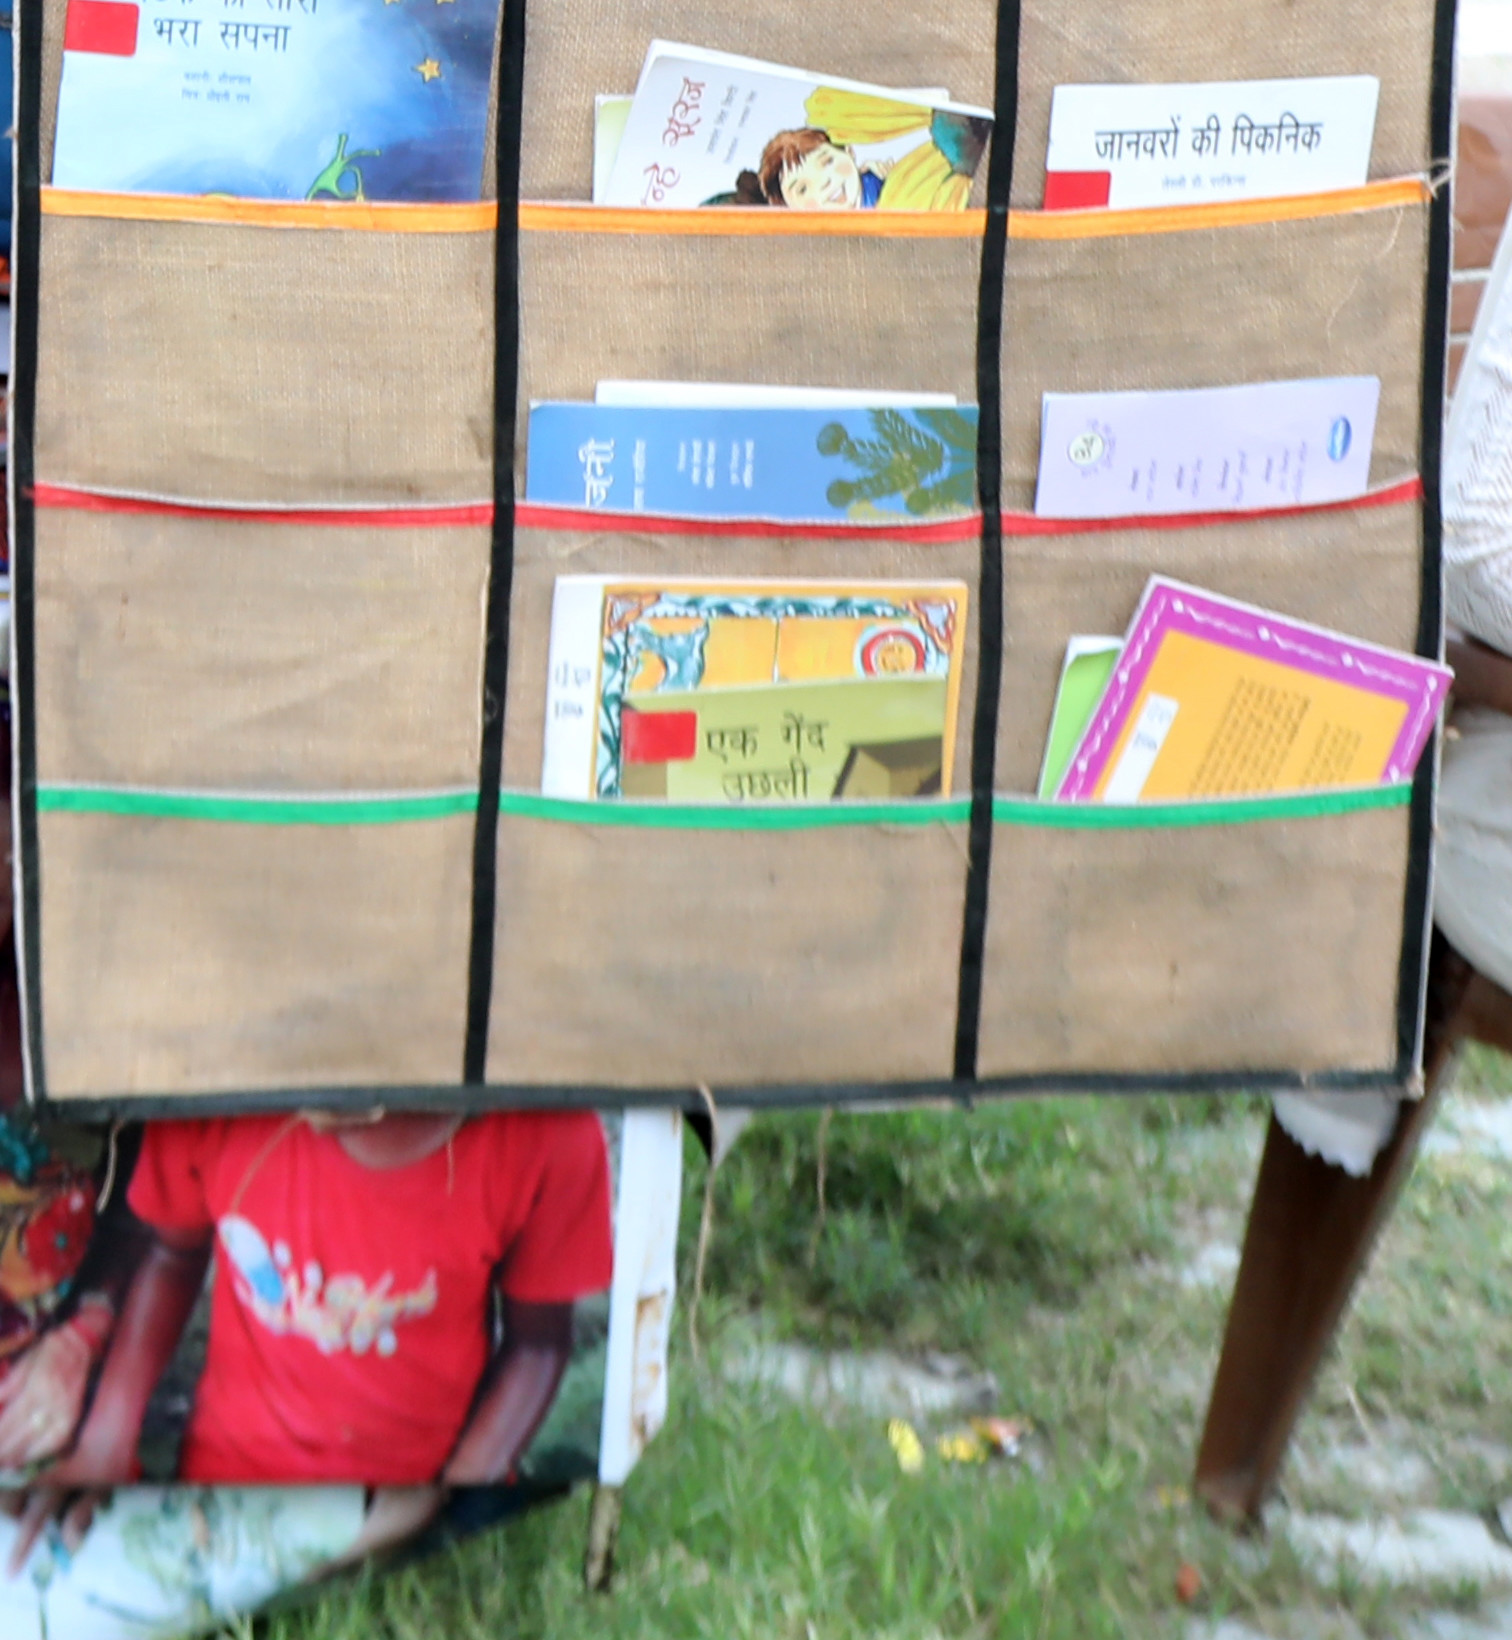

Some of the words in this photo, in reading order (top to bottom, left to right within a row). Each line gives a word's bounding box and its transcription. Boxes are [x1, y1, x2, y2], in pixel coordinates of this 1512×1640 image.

[154, 17, 202, 47] भरा
[219, 24, 291, 52] सपना
[1095, 115, 1180, 161] जानवरों
[1191, 112, 1221, 156] की
[1232, 111, 1324, 156] पिकनिक
[706, 726, 759, 763] एक
[782, 712, 829, 755] गेंद
[722, 757, 810, 801] उछली
